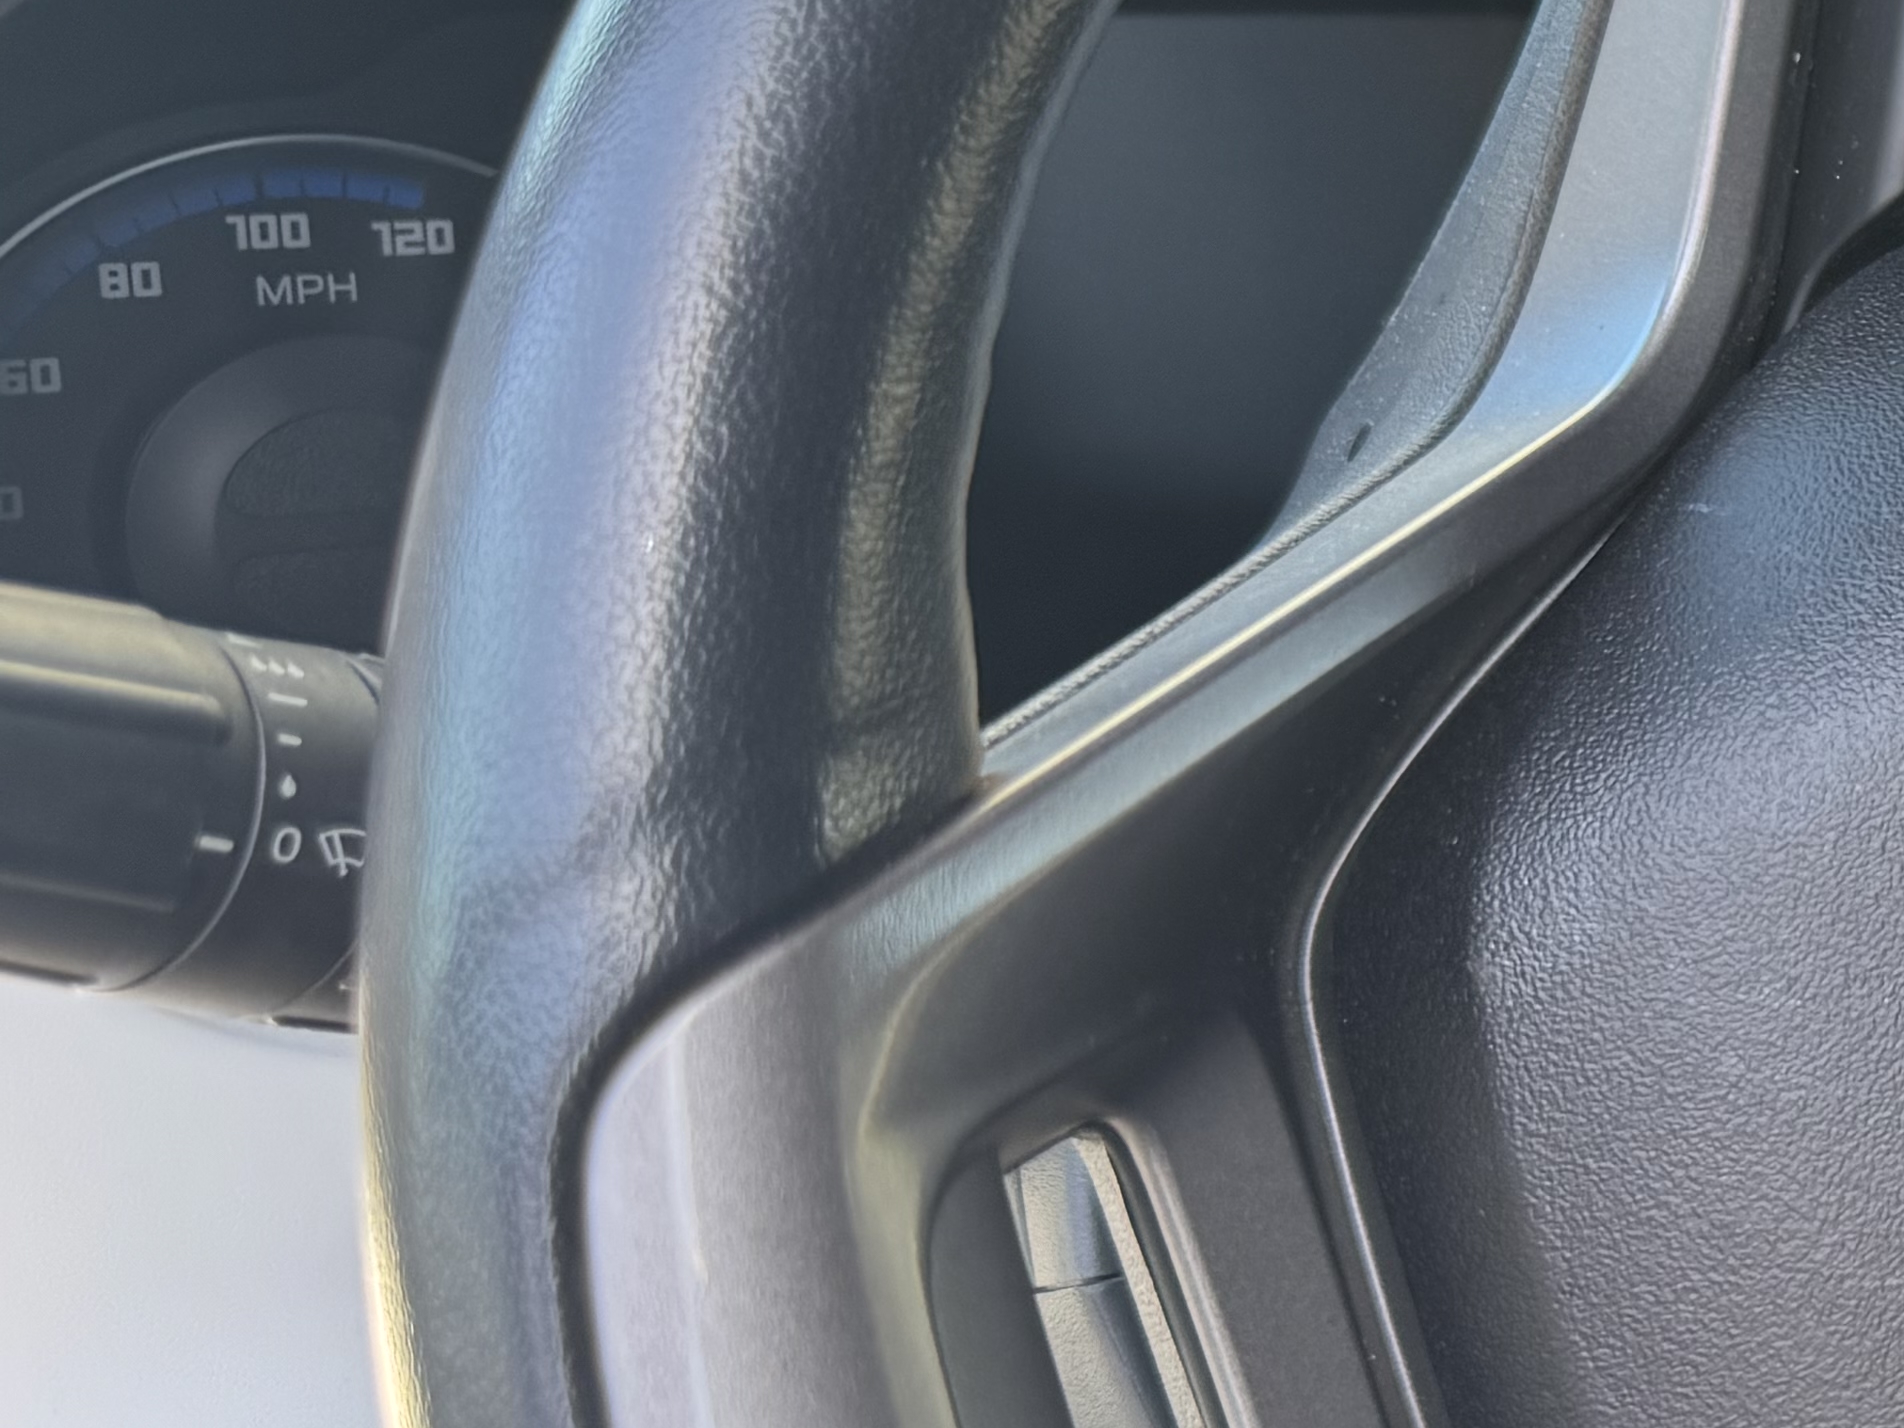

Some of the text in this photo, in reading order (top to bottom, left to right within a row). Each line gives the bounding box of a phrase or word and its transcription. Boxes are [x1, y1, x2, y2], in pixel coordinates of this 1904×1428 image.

[225, 212, 311, 251] 100
[371, 219, 455, 257] 120
[98, 261, 163, 299] 80
[256, 273, 358, 306] MPH
[0, 357, 62, 395] 60
